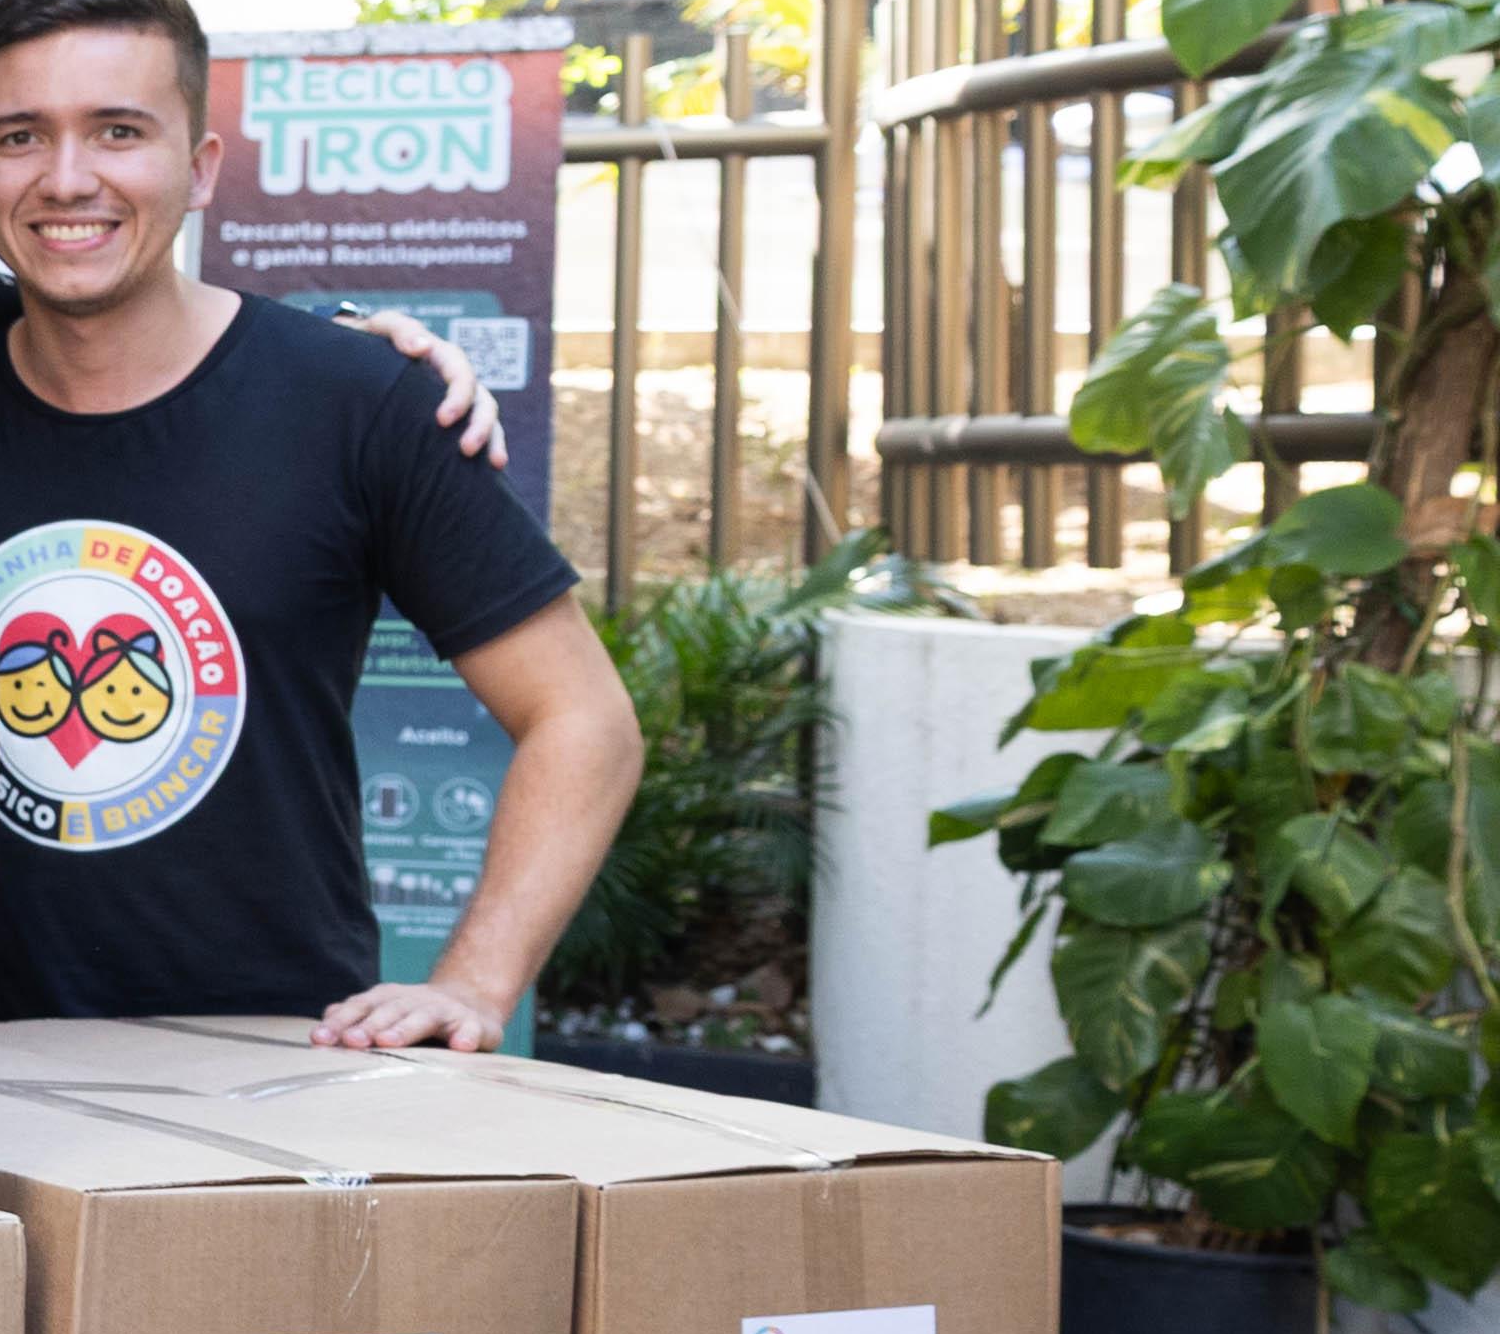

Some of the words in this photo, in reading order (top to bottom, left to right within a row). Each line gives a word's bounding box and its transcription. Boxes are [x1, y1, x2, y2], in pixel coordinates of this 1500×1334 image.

[220, 220, 329, 242] Descarte
[331, 221, 388, 241] seus
[390, 217, 529, 240] eletrônicos
[253, 246, 330, 271] ganhe
[91, 540, 134, 566] DE
[139, 557, 224, 686] DOAÇÃO
[101, 709, 228, 833] BRINCAR
